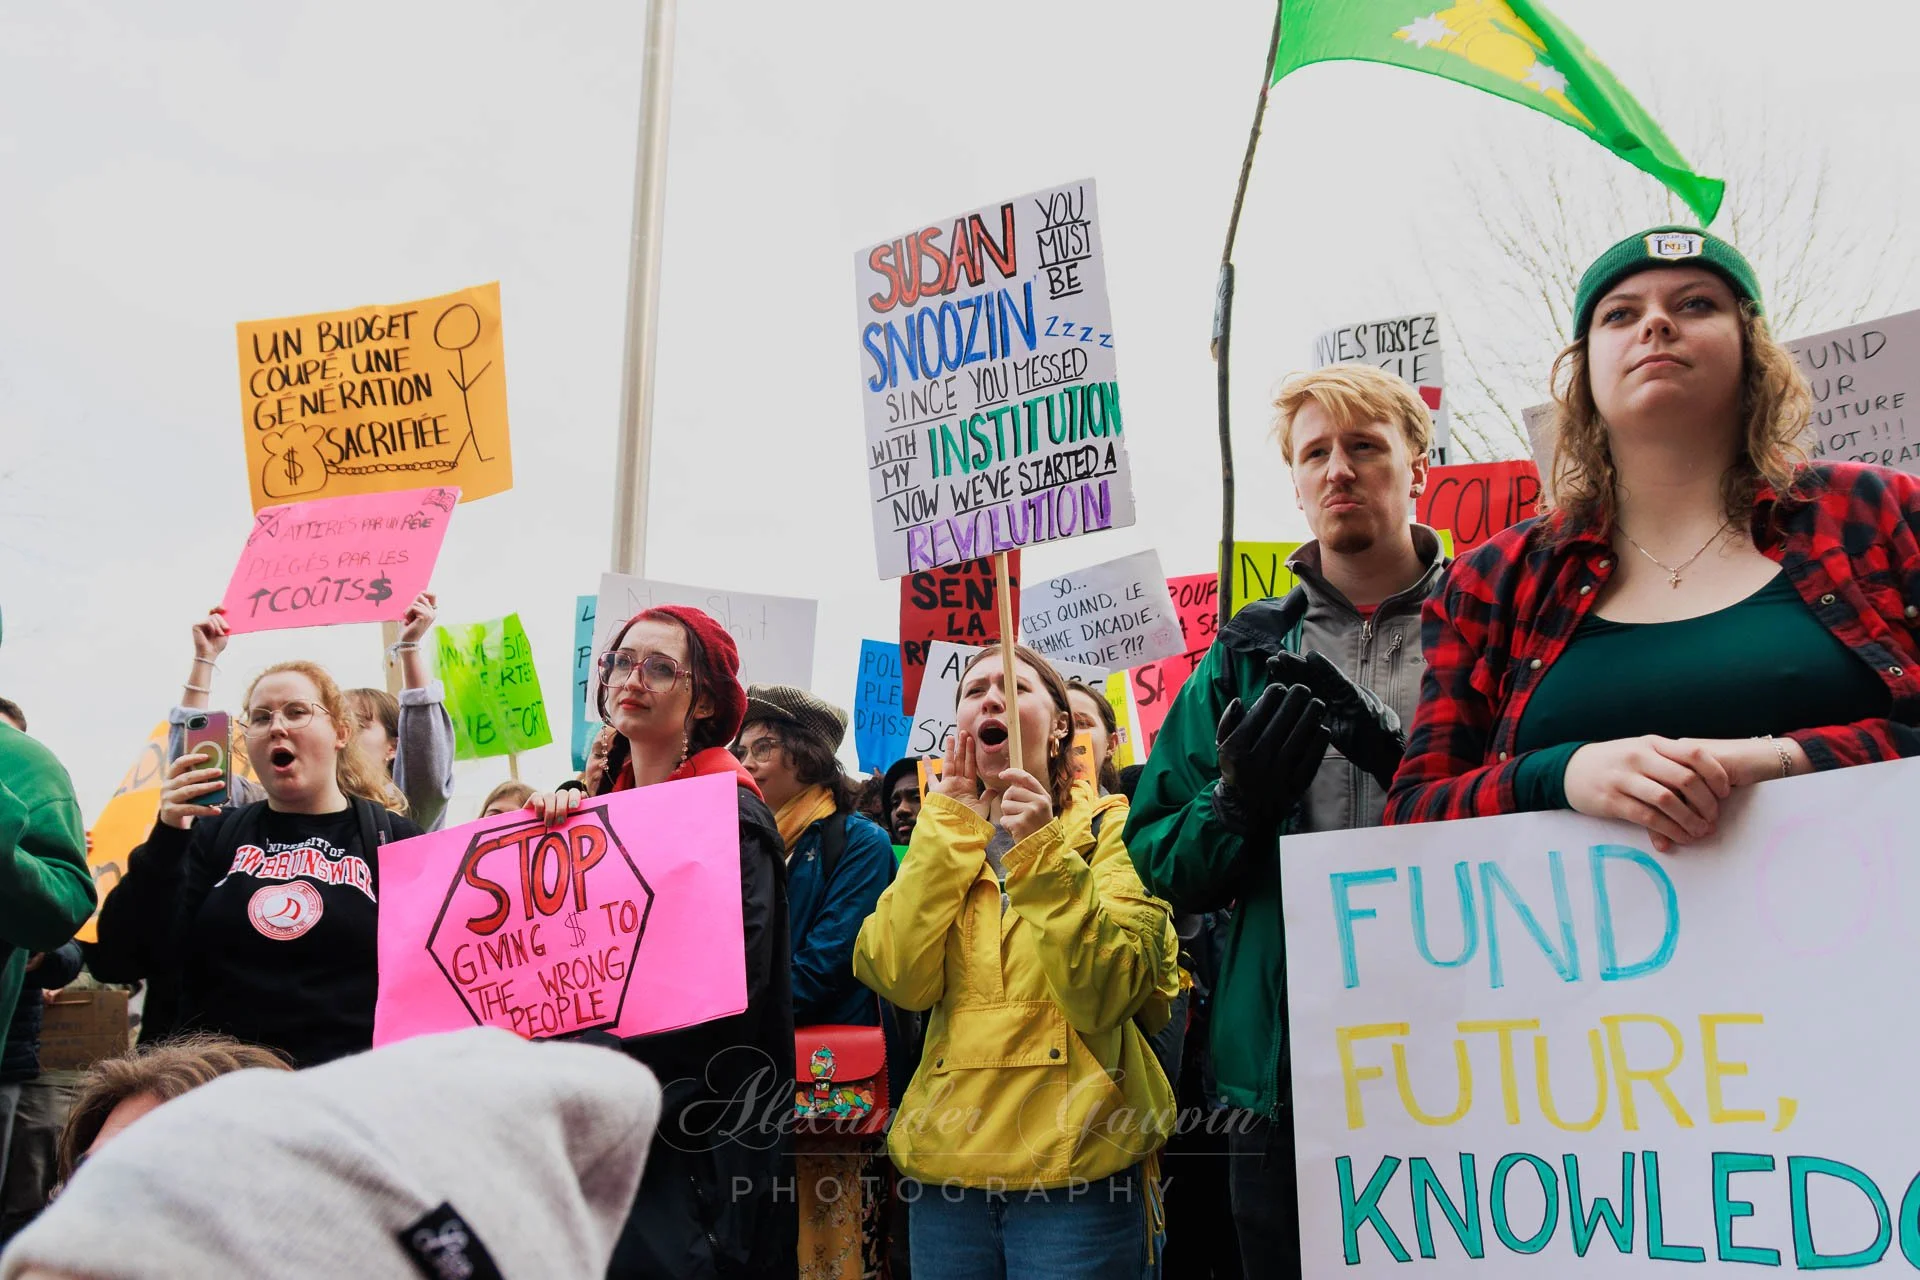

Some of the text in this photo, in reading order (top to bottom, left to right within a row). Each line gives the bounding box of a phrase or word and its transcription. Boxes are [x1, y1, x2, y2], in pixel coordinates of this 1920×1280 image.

[1035, 186, 1084, 224] YOU
[868, 202, 1017, 313] SUSAN
[1037, 221, 1092, 259] MUST
[1046, 262, 1082, 294] BE
[252, 310, 418, 364] UN BUDGET
[250, 347, 410, 399] COUPÉ, UNE
[886, 347, 1088, 424] SINCE YOU MESSED
[253, 372, 433, 431] GÉNÉRATION
[324, 412, 451, 465] SACRIFIÉE
[871, 427, 917, 464] WITH
[927, 380, 1124, 479] INSTITUTION
[881, 461, 911, 494] MY
[892, 441, 1118, 526] NOW WE'VE STARTED A
[361, 516, 383, 531] PAR
[385, 516, 400, 528] UN
[400, 510, 434, 531] RÊVE
[907, 479, 1113, 573] REVOLUTION
[337, 551, 371, 568] PAR
[377, 549, 409, 565] LES
[1021, 582, 1145, 635] C'EST QUAND, LE
[1050, 578, 1087, 599] SO...
[947, 612, 986, 636] LA
[1027, 628, 1075, 655] REMAKE
[266, 837, 345, 858] NIVERSITY OF
[464, 824, 608, 937] STOP
[452, 900, 640, 985] GIVING $ TO
[1330, 844, 1680, 988] FUND
[468, 946, 626, 1021] THE WRONG
[509, 989, 607, 1037] PEOPLE
[1335, 1012, 1798, 1133] FUTURE,
[1335, 1150, 1920, 1271] KNOWLED
